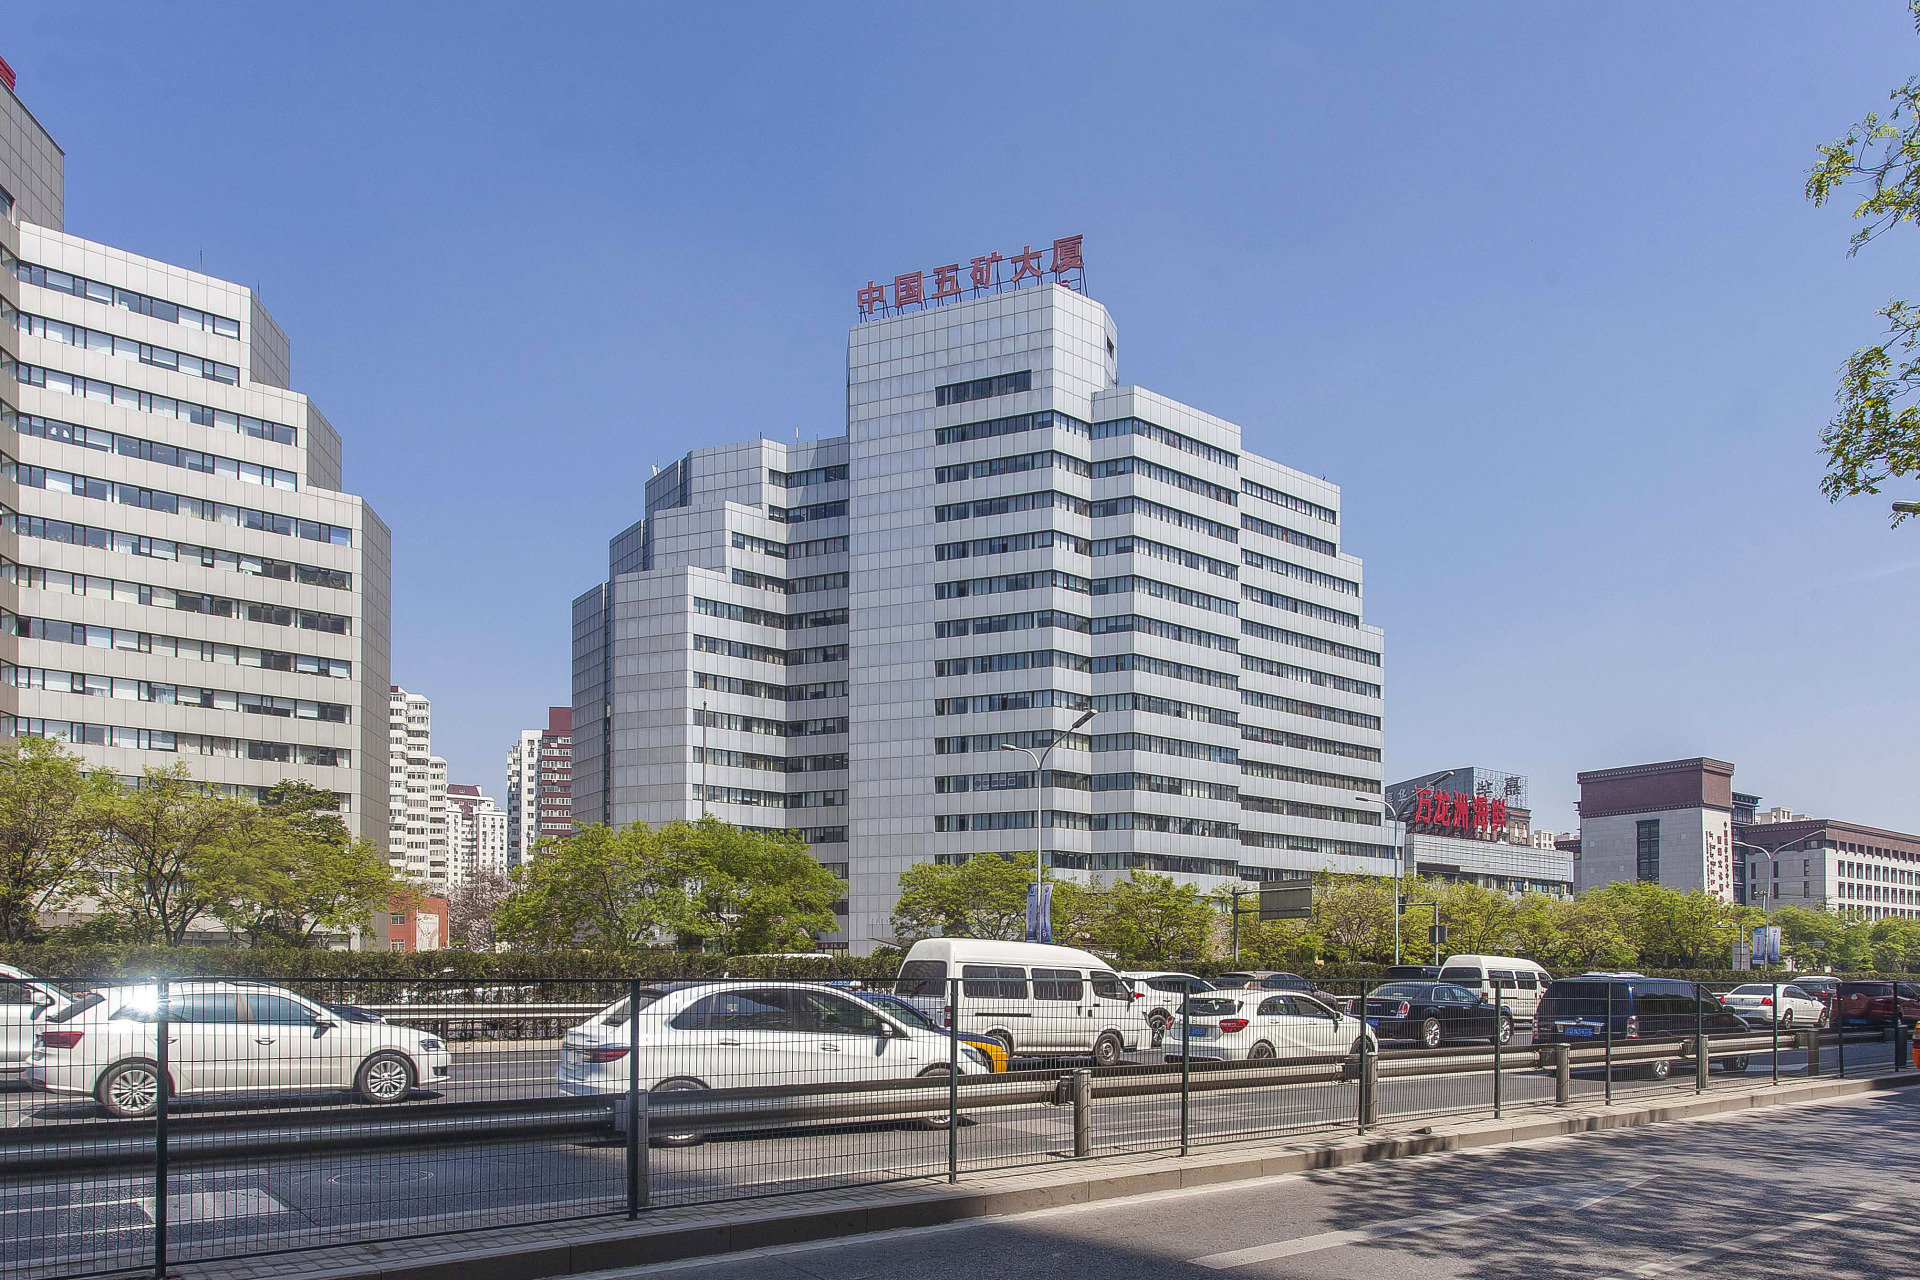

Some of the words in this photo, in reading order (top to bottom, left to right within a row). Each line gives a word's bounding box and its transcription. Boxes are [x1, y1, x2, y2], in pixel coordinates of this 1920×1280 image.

[857, 234, 1084, 315] 中国五矿大厦
[1415, 787, 1507, 832] 万龙洲海鲜
